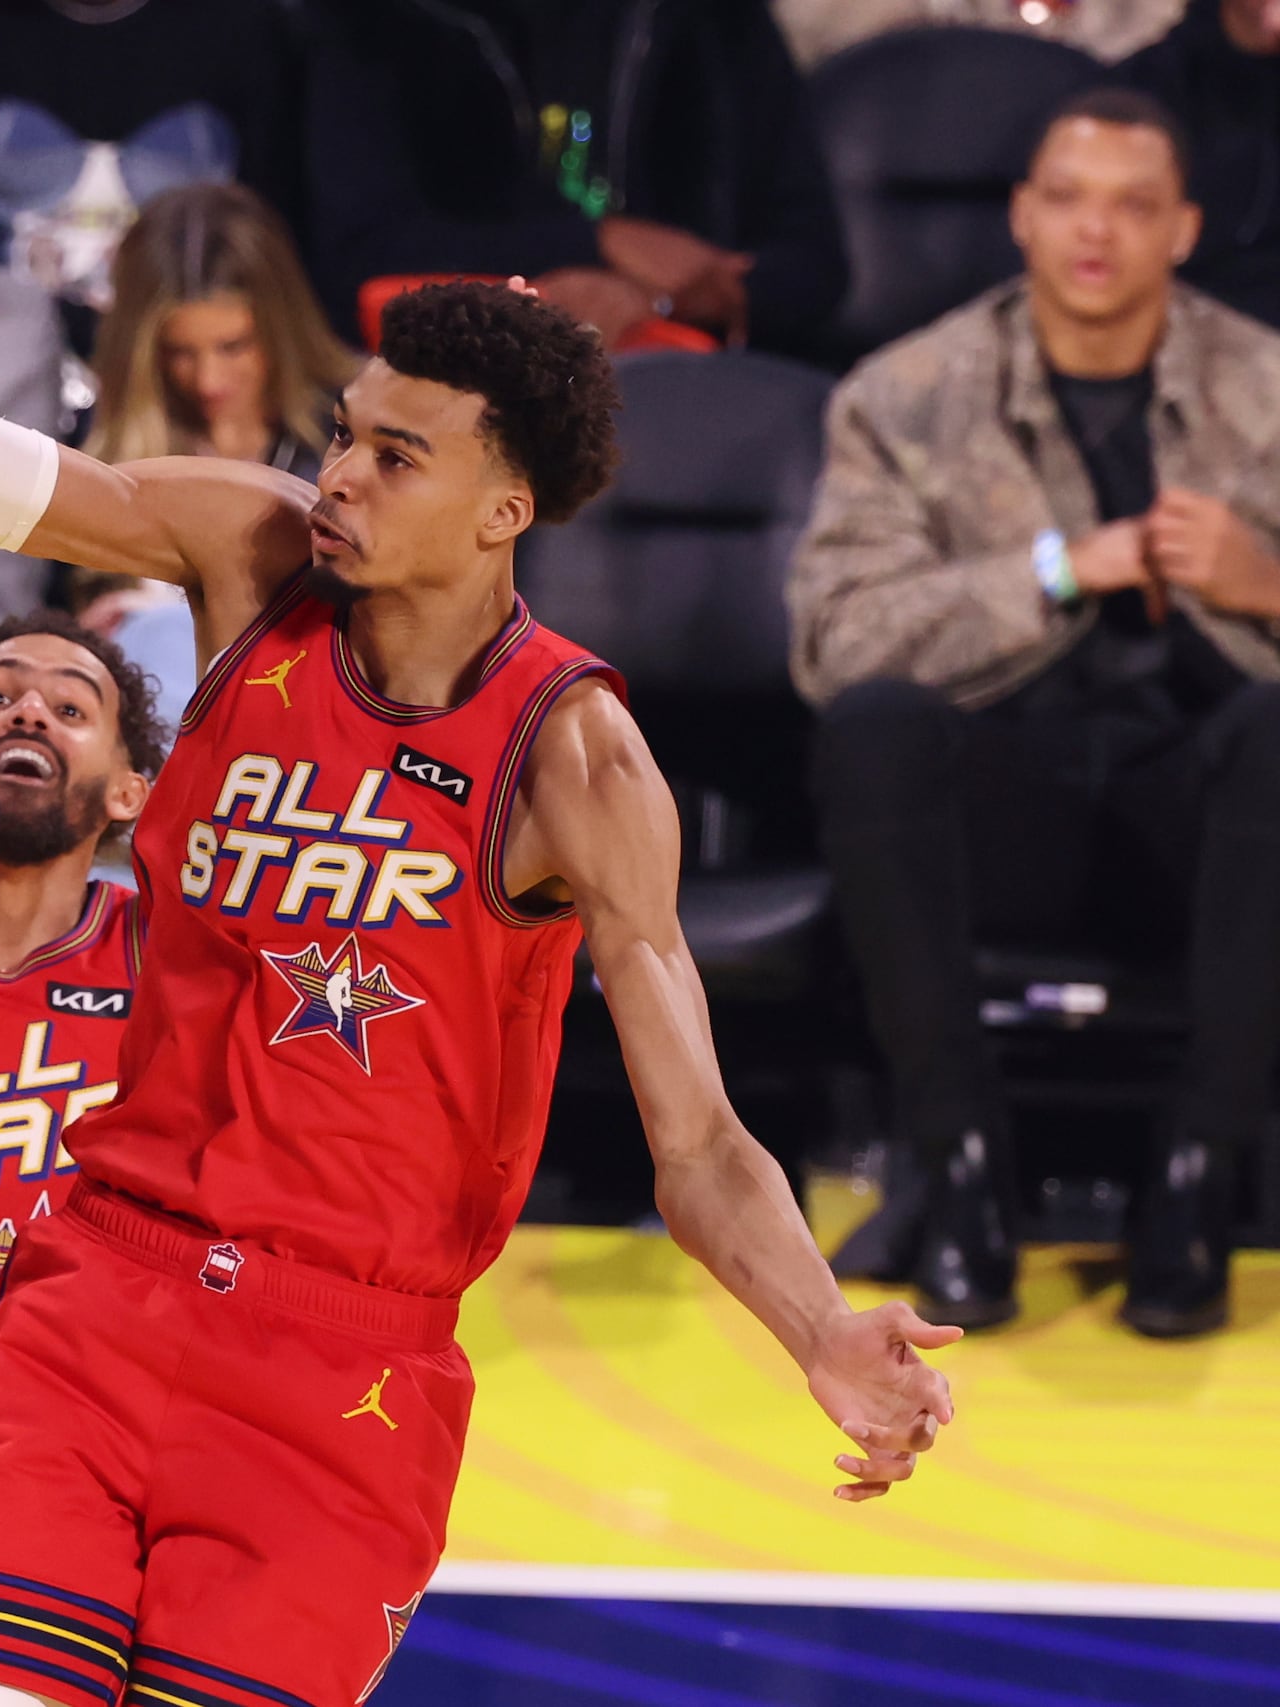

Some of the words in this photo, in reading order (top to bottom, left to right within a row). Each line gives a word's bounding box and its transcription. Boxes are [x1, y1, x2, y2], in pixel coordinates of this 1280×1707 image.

[211, 752, 413, 846] ALL
[398, 753, 466, 796] KIA
[179, 819, 464, 929] STAR
[52, 988, 124, 1013] KIA
